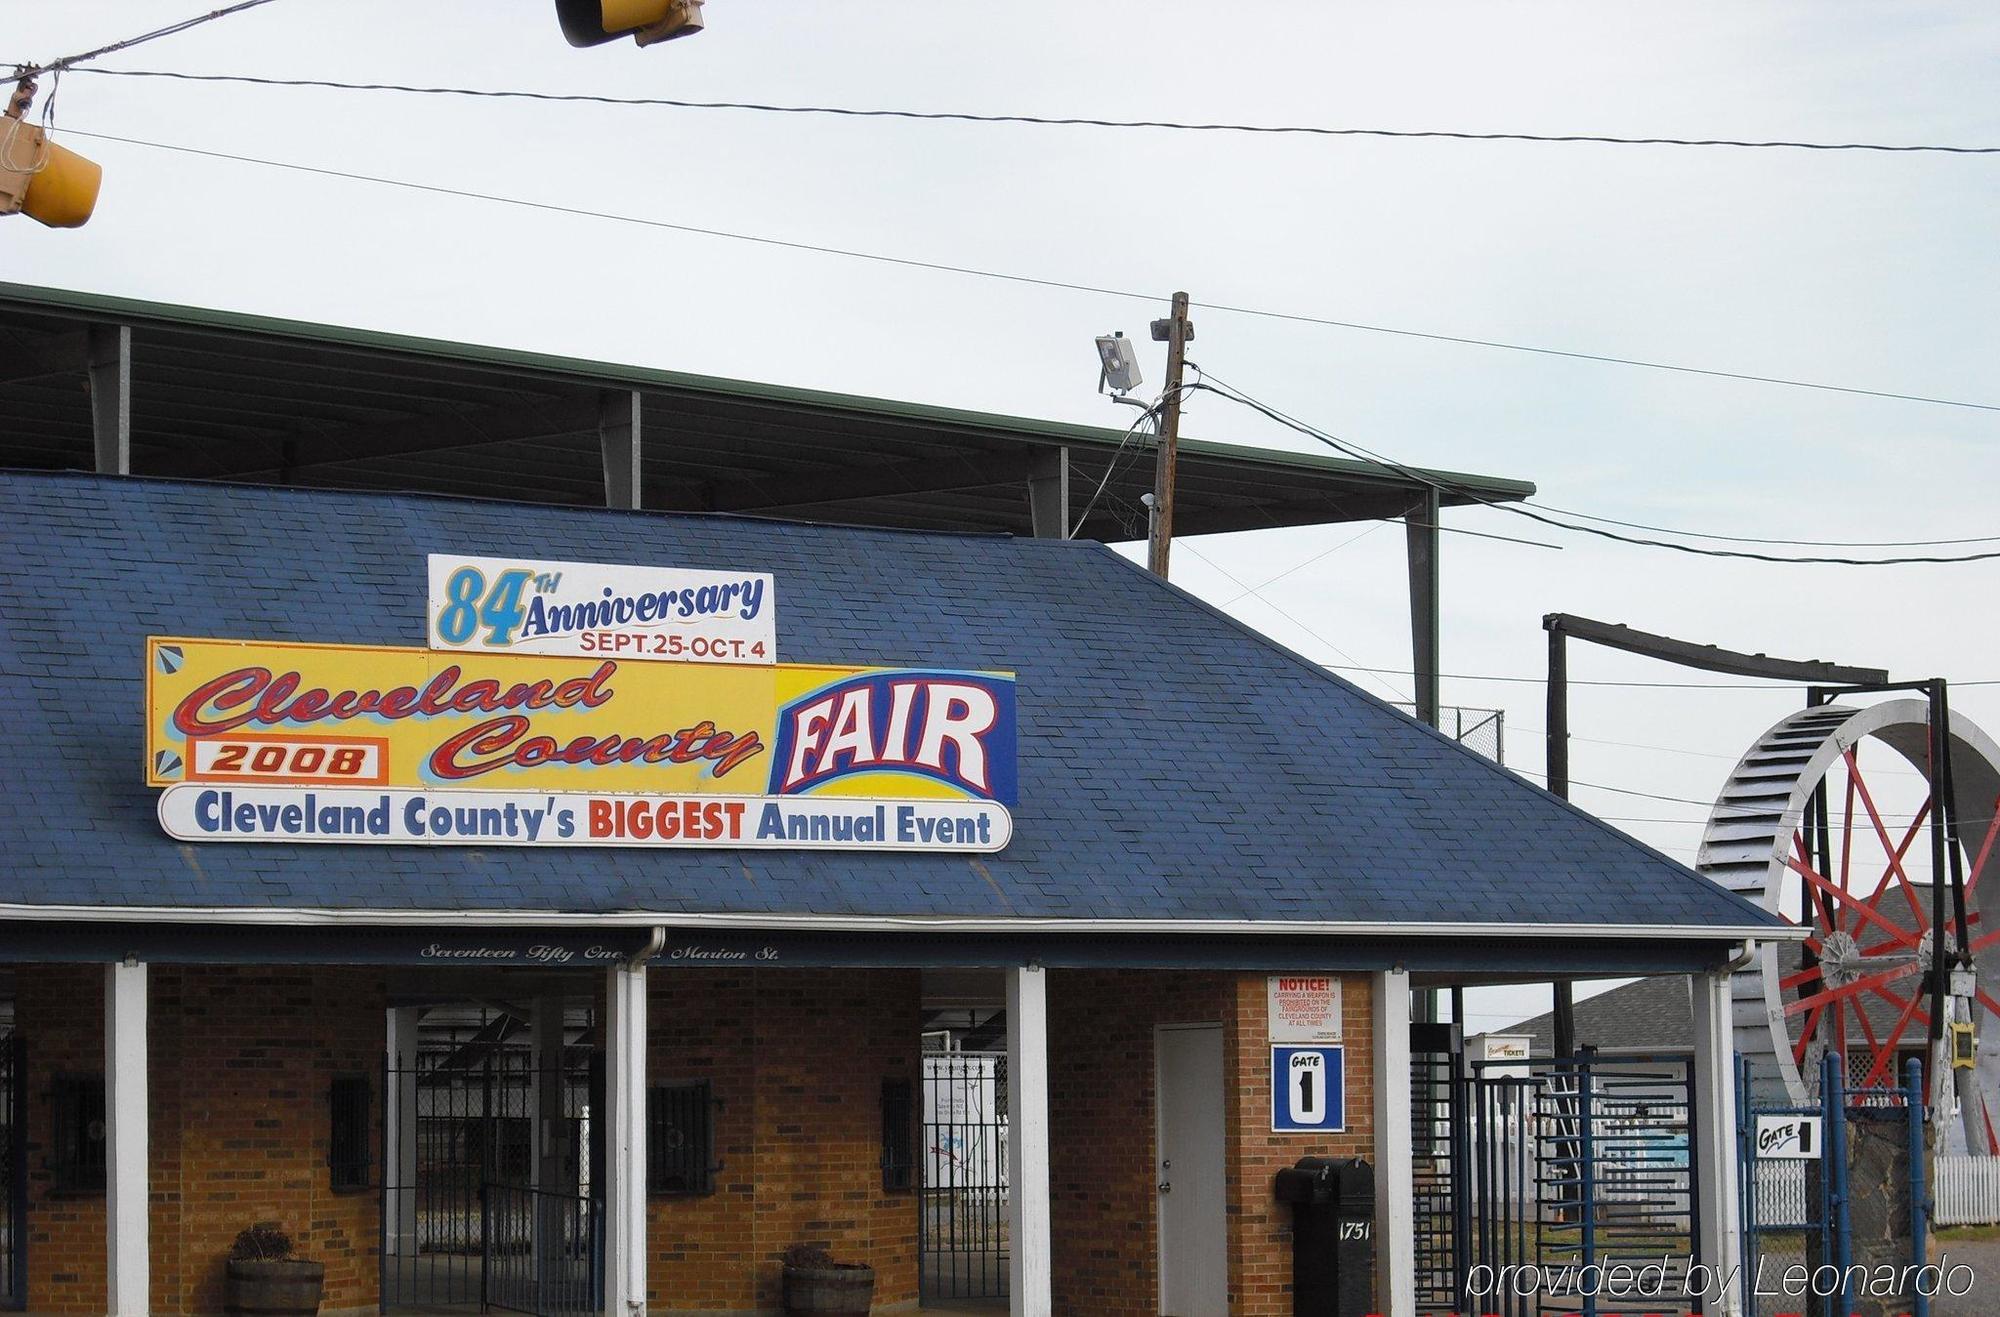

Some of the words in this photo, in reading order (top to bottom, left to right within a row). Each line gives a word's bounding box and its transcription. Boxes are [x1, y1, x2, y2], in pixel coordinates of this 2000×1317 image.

[521, 578, 764, 637] Anniversary
[173, 660, 617, 736] Cleveland
[430, 715, 765, 779] County
[781, 682, 994, 794] FAIR
[210, 745, 366, 775] 2008
[194, 790, 390, 835] Cleveland
[403, 797, 574, 842] County's
[589, 800, 745, 840] BIGGEST
[756, 804, 885, 842] Annual
[897, 806, 991, 844] Event
[420, 943, 517, 958] Seventeen
[525, 945, 575, 962] Fifty
[584, 945, 622, 959] One
[670, 945, 748, 960] Marion
[1279, 978, 1330, 991] NOTICE!
[1292, 1056, 1320, 1068] GATE
[1504, 1049, 1525, 1057] TICKETS
[1299, 1071, 1313, 1112] 1
[1759, 1124, 1795, 1150] GATE
[1798, 1122, 1811, 1152] 1
[1340, 1222, 1370, 1241] 1751
